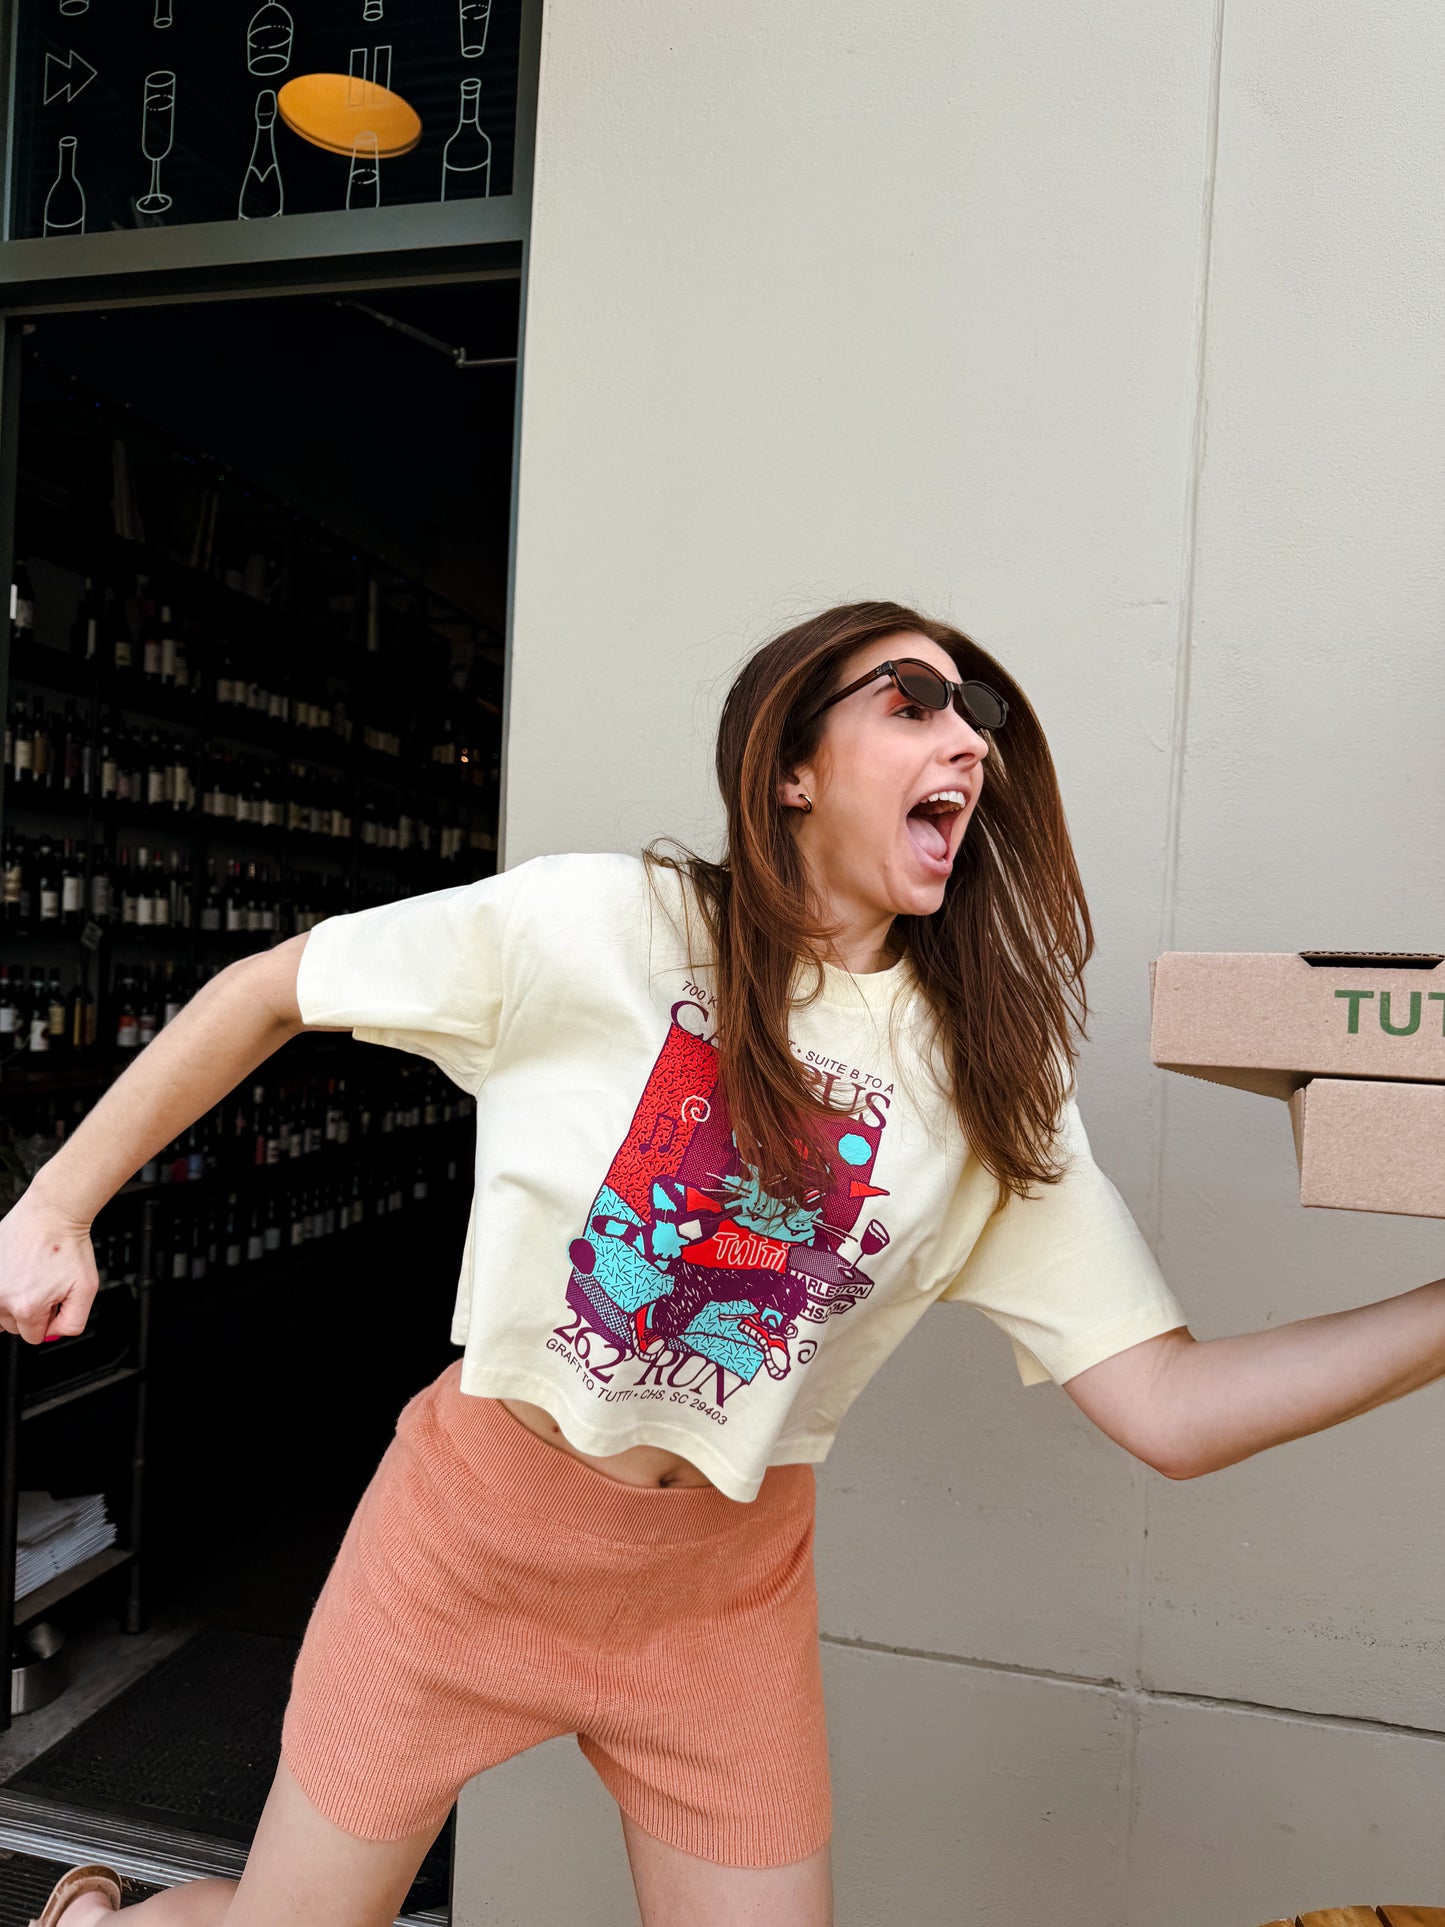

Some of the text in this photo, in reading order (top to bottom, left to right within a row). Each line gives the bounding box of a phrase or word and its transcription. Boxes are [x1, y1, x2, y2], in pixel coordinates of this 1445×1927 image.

[681, 980, 707, 1001] 700
[805, 1050, 848, 1075] SUITE
[849, 1068, 860, 1080] B
[864, 1073, 883, 1089] TO
[884, 1083, 894, 1095] A
[545, 1338, 728, 1426] GRAFT TO TUTTI CHS, SC 29403
[632, 1347, 750, 1409] RUN
